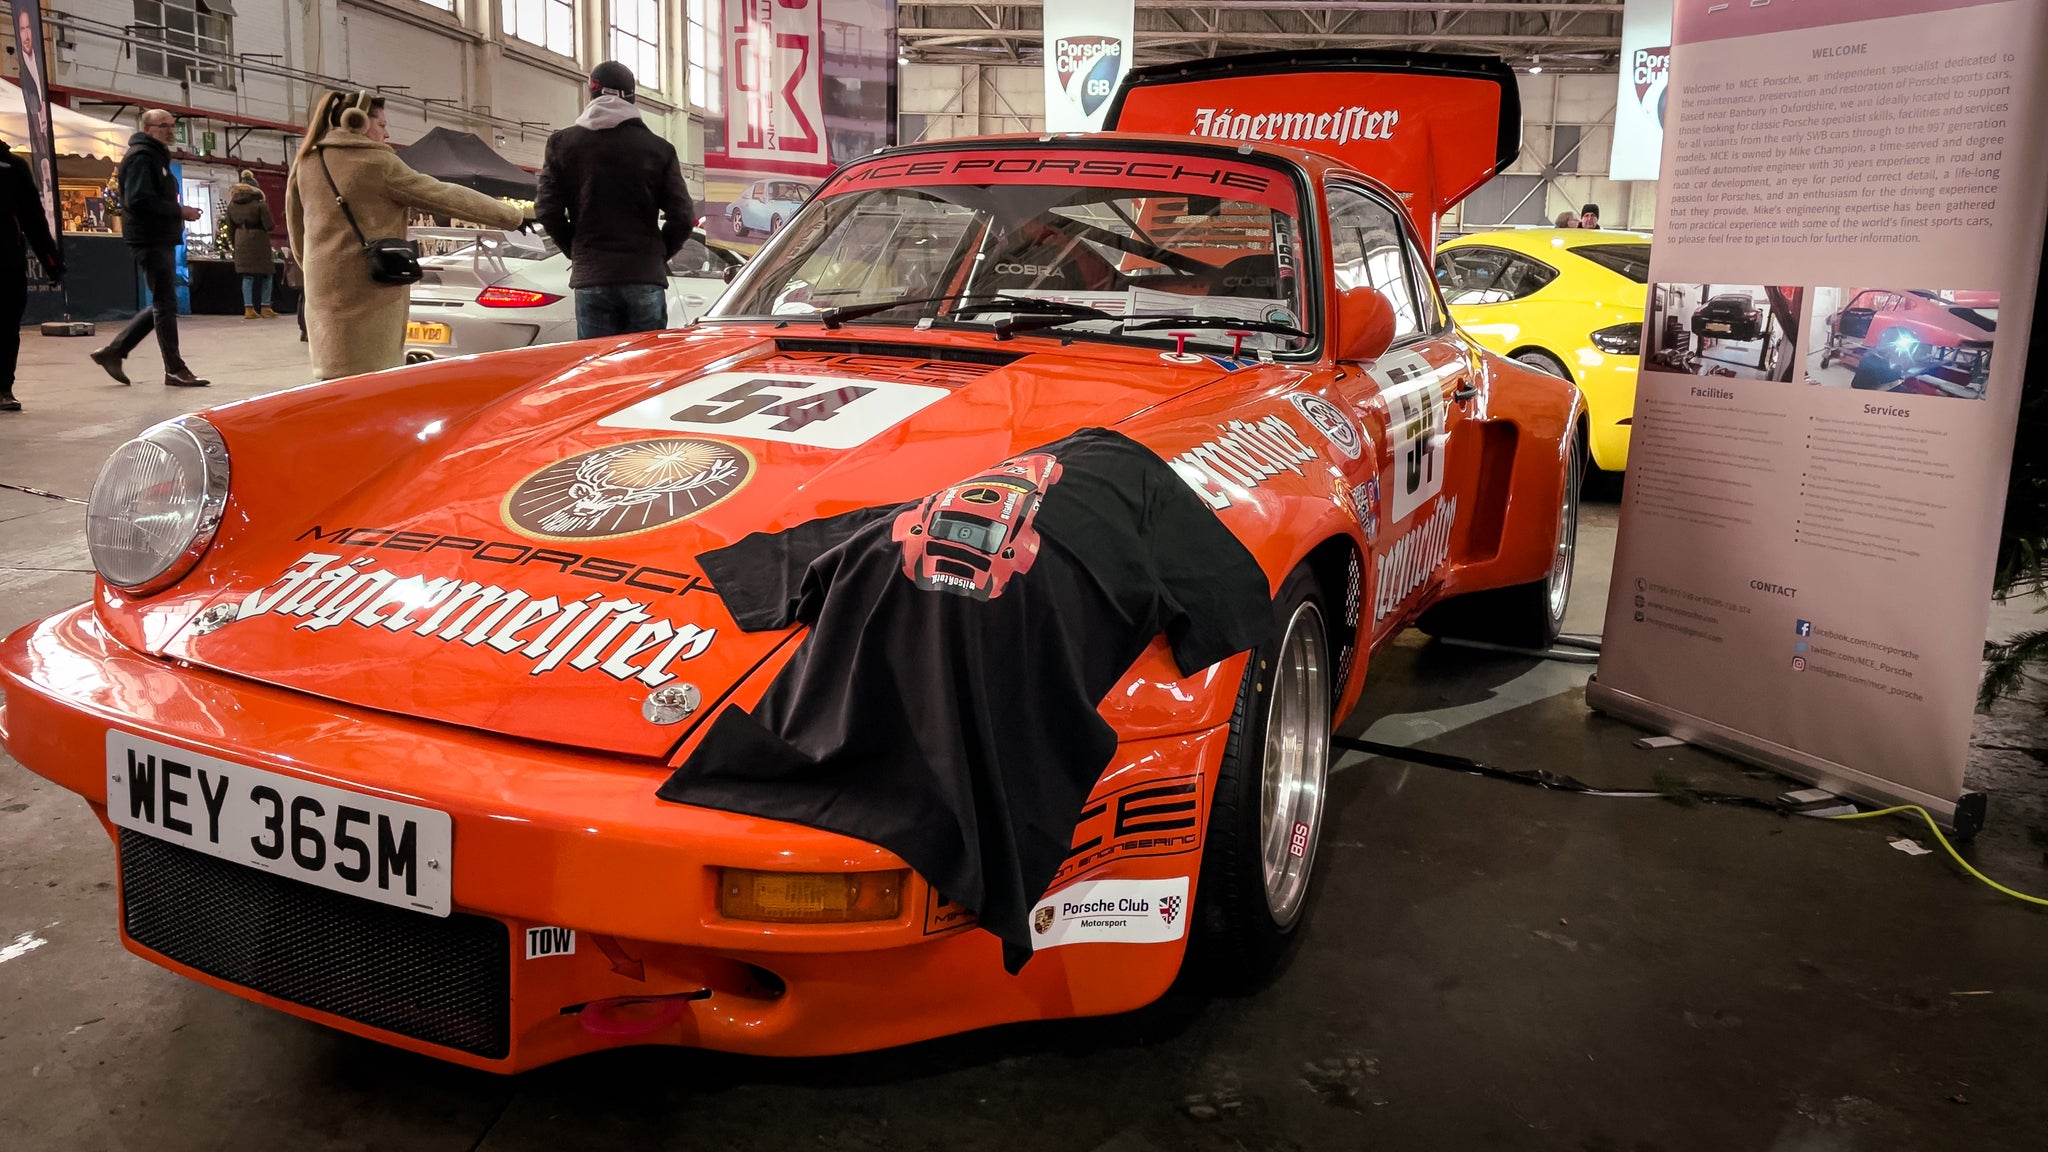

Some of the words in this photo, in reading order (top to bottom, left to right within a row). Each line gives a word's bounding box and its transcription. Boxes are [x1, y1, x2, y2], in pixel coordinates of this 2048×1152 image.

[1057, 40, 1120, 56] Porsche
[1812, 43, 1868, 59] WELCOME
[1683, 83, 1721, 95] Welcome
[1725, 80, 1735, 91] to
[1740, 78, 1758, 89] MCE
[1763, 74, 1802, 87] Porsche,
[1807, 74, 1819, 83] an
[1824, 65, 1886, 81] independent
[1891, 59, 1938, 76] specialist
[1944, 53, 1997, 68] dedicated
[2003, 52, 2015, 63] to
[1087, 79, 1110, 96] GB
[1681, 98, 1694, 108] the
[1697, 95, 1756, 107] maintenance,
[1759, 88, 1816, 104] preservation
[1820, 85, 1837, 96] and
[1839, 81, 1893, 94] restoration
[1908, 75, 1949, 88] Porsche
[1951, 71, 1983, 86] sports
[1986, 71, 2012, 81] cars.
[1680, 110, 1704, 122] Based
[1707, 111, 1727, 120] near
[1729, 106, 1767, 118] Banbury
[1770, 105, 1778, 115] in
[1781, 101, 1837, 114] Oxfordshire,
[1840, 101, 1854, 109] we
[1857, 100, 1872, 108] are
[1876, 95, 1909, 107] ideally
[1913, 89, 1950, 104] located
[1954, 88, 1964, 99] to
[1968, 84, 2010, 99] support
[1190, 105, 1399, 146] Jägermeister
[1678, 124, 1700, 135] those
[1703, 122, 1735, 134] looking
[1736, 121, 1749, 131] for
[1751, 119, 1780, 130] classic
[1783, 116, 1820, 129] Porsche
[1822, 112, 1865, 127] specialist
[1869, 110, 1895, 122] skills,
[1898, 107, 1940, 120] facilities
[1943, 105, 1962, 116] and
[1965, 103, 2008, 115] services
[1677, 139, 1688, 150] for
[1690, 138, 1700, 149] all
[1703, 136, 1738, 148] variants
[1740, 135, 1761, 146] from
[1763, 133, 1779, 144] the
[1781, 132, 1804, 144] early
[1807, 130, 1827, 141] SWB
[1830, 131, 1849, 140] cars
[1852, 126, 1891, 140] through
[1894, 125, 1904, 136] to
[1908, 124, 1924, 135] the
[1927, 123, 1944, 133] 997
[1948, 119, 2006, 135] generation
[1676, 151, 1707, 162] models.
[1710, 150, 1728, 161] MCE
[1742, 147, 1771, 159] owned
[1775, 147, 1786, 160] by
[1789, 146, 1811, 157] Mike
[1813, 143, 1866, 157] Champion,
[1880, 138, 1938, 151] time-served
[1942, 136, 1962, 148] and
[1966, 136, 2004, 148] degree
[836, 161, 947, 187] MCE
[953, 159, 1271, 193] PORSCHE
[1674, 164, 1710, 178] qualified
[1713, 163, 1763, 175] automotive
[1766, 162, 1805, 175] engineer
[1808, 159, 1829, 171] with
[1832, 159, 1844, 169] 30
[1847, 159, 1873, 171] years
[1876, 155, 1930, 169] experience
[1936, 153, 1945, 164] in
[1950, 152, 1974, 163] road
[1980, 150, 2002, 162] and
[1673, 181, 1690, 189] race
[1693, 181, 1707, 189] car
[1711, 176, 1772, 190] development,
[1776, 178, 1787, 186] an
[1792, 177, 1808, 188] eye
[1812, 174, 1826, 185] for
[1830, 172, 1862, 187] period
[1866, 171, 1901, 182] correct
[1906, 170, 1938, 181] detail,
[1955, 168, 2000, 180] life-long
[1672, 192, 1703, 206] passion
[1706, 192, 1719, 202] for
[1721, 191, 1763, 202] Porsches,
[1767, 190, 1784, 201] and
[1788, 192, 1799, 200] an
[1803, 188, 1858, 199] enthusiasm
[1862, 187, 1876, 197] for
[1880, 186, 1896, 197] the
[1900, 186, 1935, 198] driving
[1939, 184, 1998, 198] experience
[1670, 206, 1686, 217] that
[1690, 206, 1709, 219] they
[1713, 205, 1749, 219] provide.
[1753, 204, 1781, 215] Mike's
[1785, 204, 1840, 217] engineering
[1845, 202, 1890, 216] expertise
[1893, 202, 1911, 212] has
[1916, 201, 1941, 211] been
[1946, 200, 1996, 213] gathered
[1669, 220, 1687, 230] from
[1690, 219, 1727, 232] practical
[1729, 219, 1777, 232] experience
[1780, 218, 1799, 229] with
[1802, 220, 1828, 228] some
[1830, 218, 1840, 228] of
[1843, 217, 1859, 228] the
[1861, 217, 1897, 228] world's
[1901, 216, 1929, 227] finest
[1931, 216, 1963, 229] sports
[1966, 218, 1993, 227] cars,
[1678, 233, 1705, 246] please
[1708, 233, 1724, 244] feel
[1726, 233, 1742, 244] free
[1744, 233, 1753, 243] to
[1755, 233, 1769, 246] get
[1782, 233, 1808, 243] touch
[1810, 233, 1823, 243] for
[1825, 233, 1858, 243] further
[1860, 233, 1920, 243] information.
[994, 263, 1065, 279] COBRA
[670, 379, 878, 432] 54
[1690, 387, 1734, 400] Facilities
[1863, 403, 1911, 418] Services
[1750, 579, 1798, 599] CONTACT
[237, 551, 717, 687] Jägermeister
[127, 748, 229, 845] WEY
[250, 784, 418, 898] 365M
[1290, 823, 1308, 857] BBS
[1063, 899, 1115, 916] Porsche
[1118, 898, 1150, 912] Club
[1081, 919, 1127, 929] Motorsport
[529, 928, 572, 956] TOW
